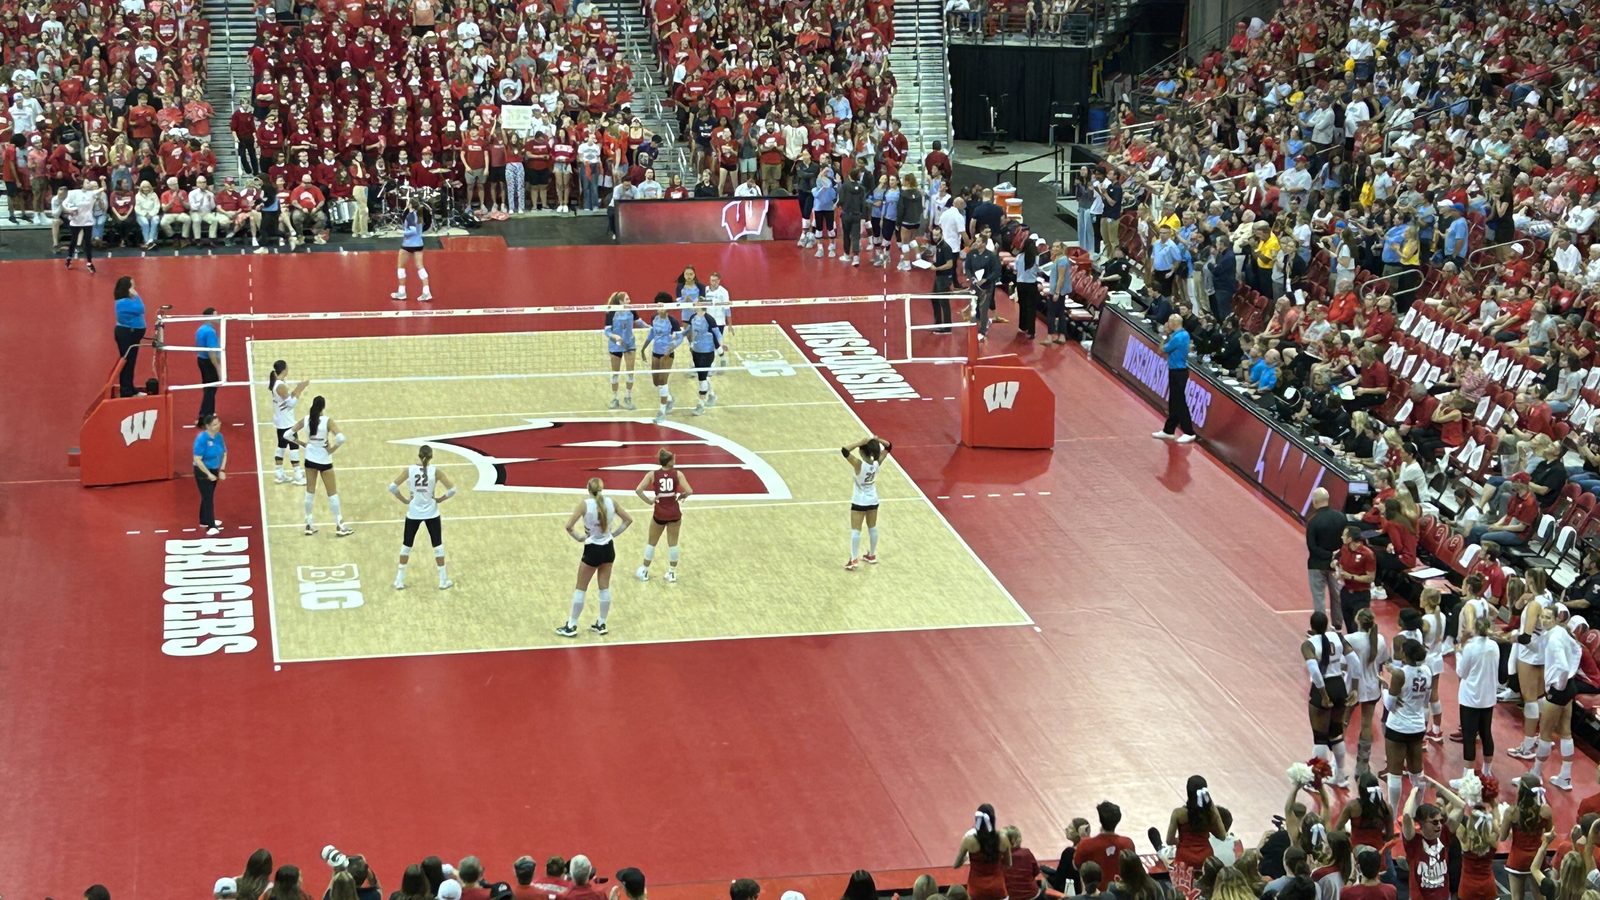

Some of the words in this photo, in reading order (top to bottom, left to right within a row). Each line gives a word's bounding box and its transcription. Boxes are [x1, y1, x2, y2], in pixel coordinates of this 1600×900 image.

[791, 321, 921, 400] WISCONSIN
[982, 381, 1020, 413] W
[120, 409, 158, 447] W
[414, 473, 428, 487] 22
[659, 477, 674, 492] 30
[161, 537, 258, 656] BADGERS
[1412, 677, 1427, 692] 52
